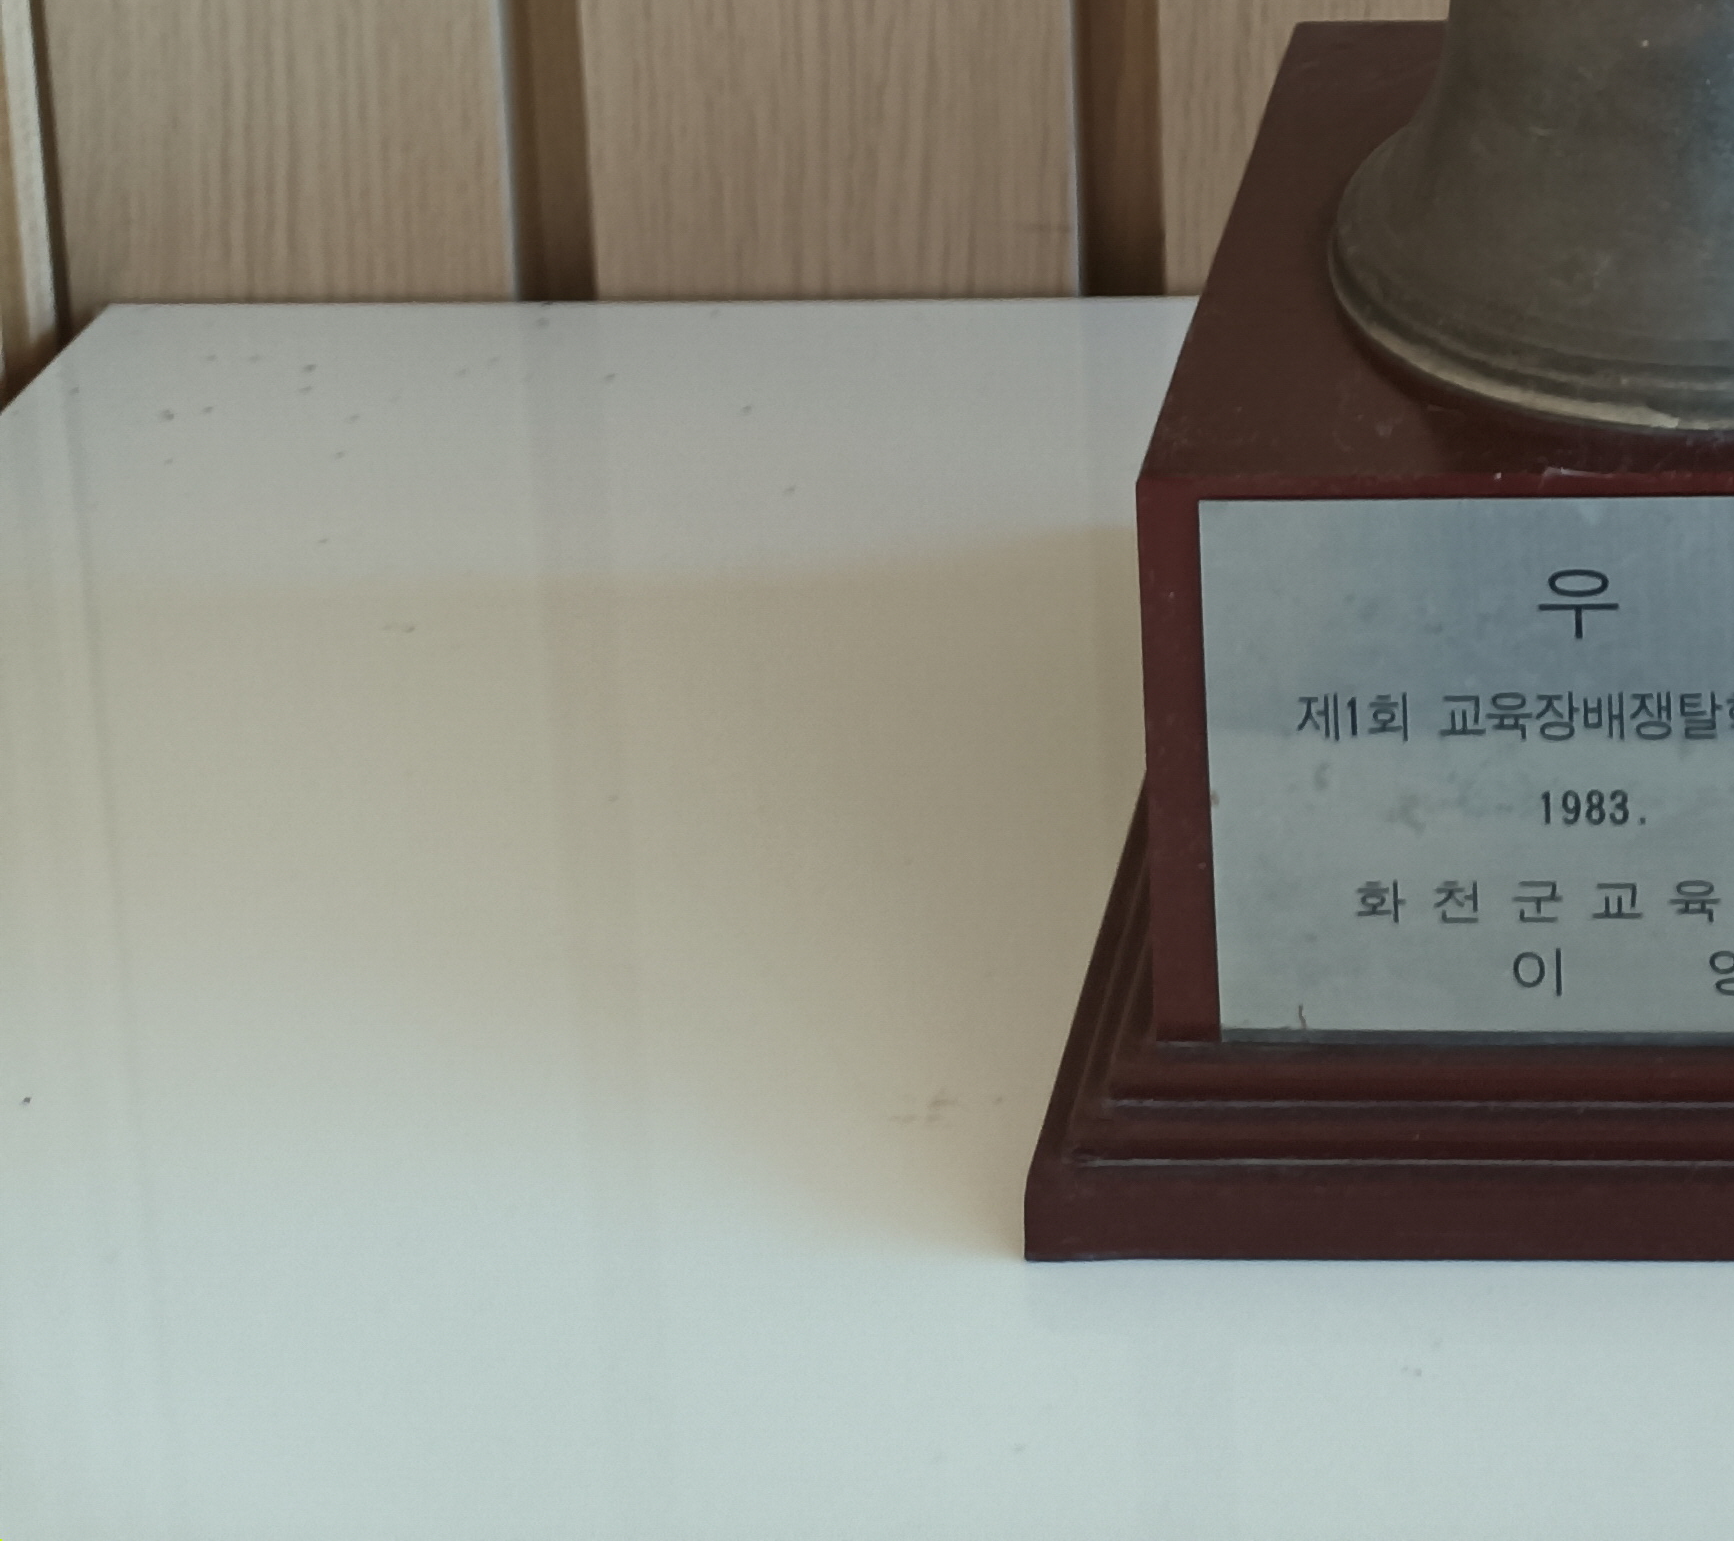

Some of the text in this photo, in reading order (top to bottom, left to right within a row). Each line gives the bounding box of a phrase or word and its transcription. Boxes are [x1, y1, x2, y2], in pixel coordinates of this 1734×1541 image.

[1538, 568, 1620, 641] 우
[1296, 691, 1409, 743] 제1회
[1540, 788, 1648, 828] 1983.
[1512, 947, 1563, 998] 이
